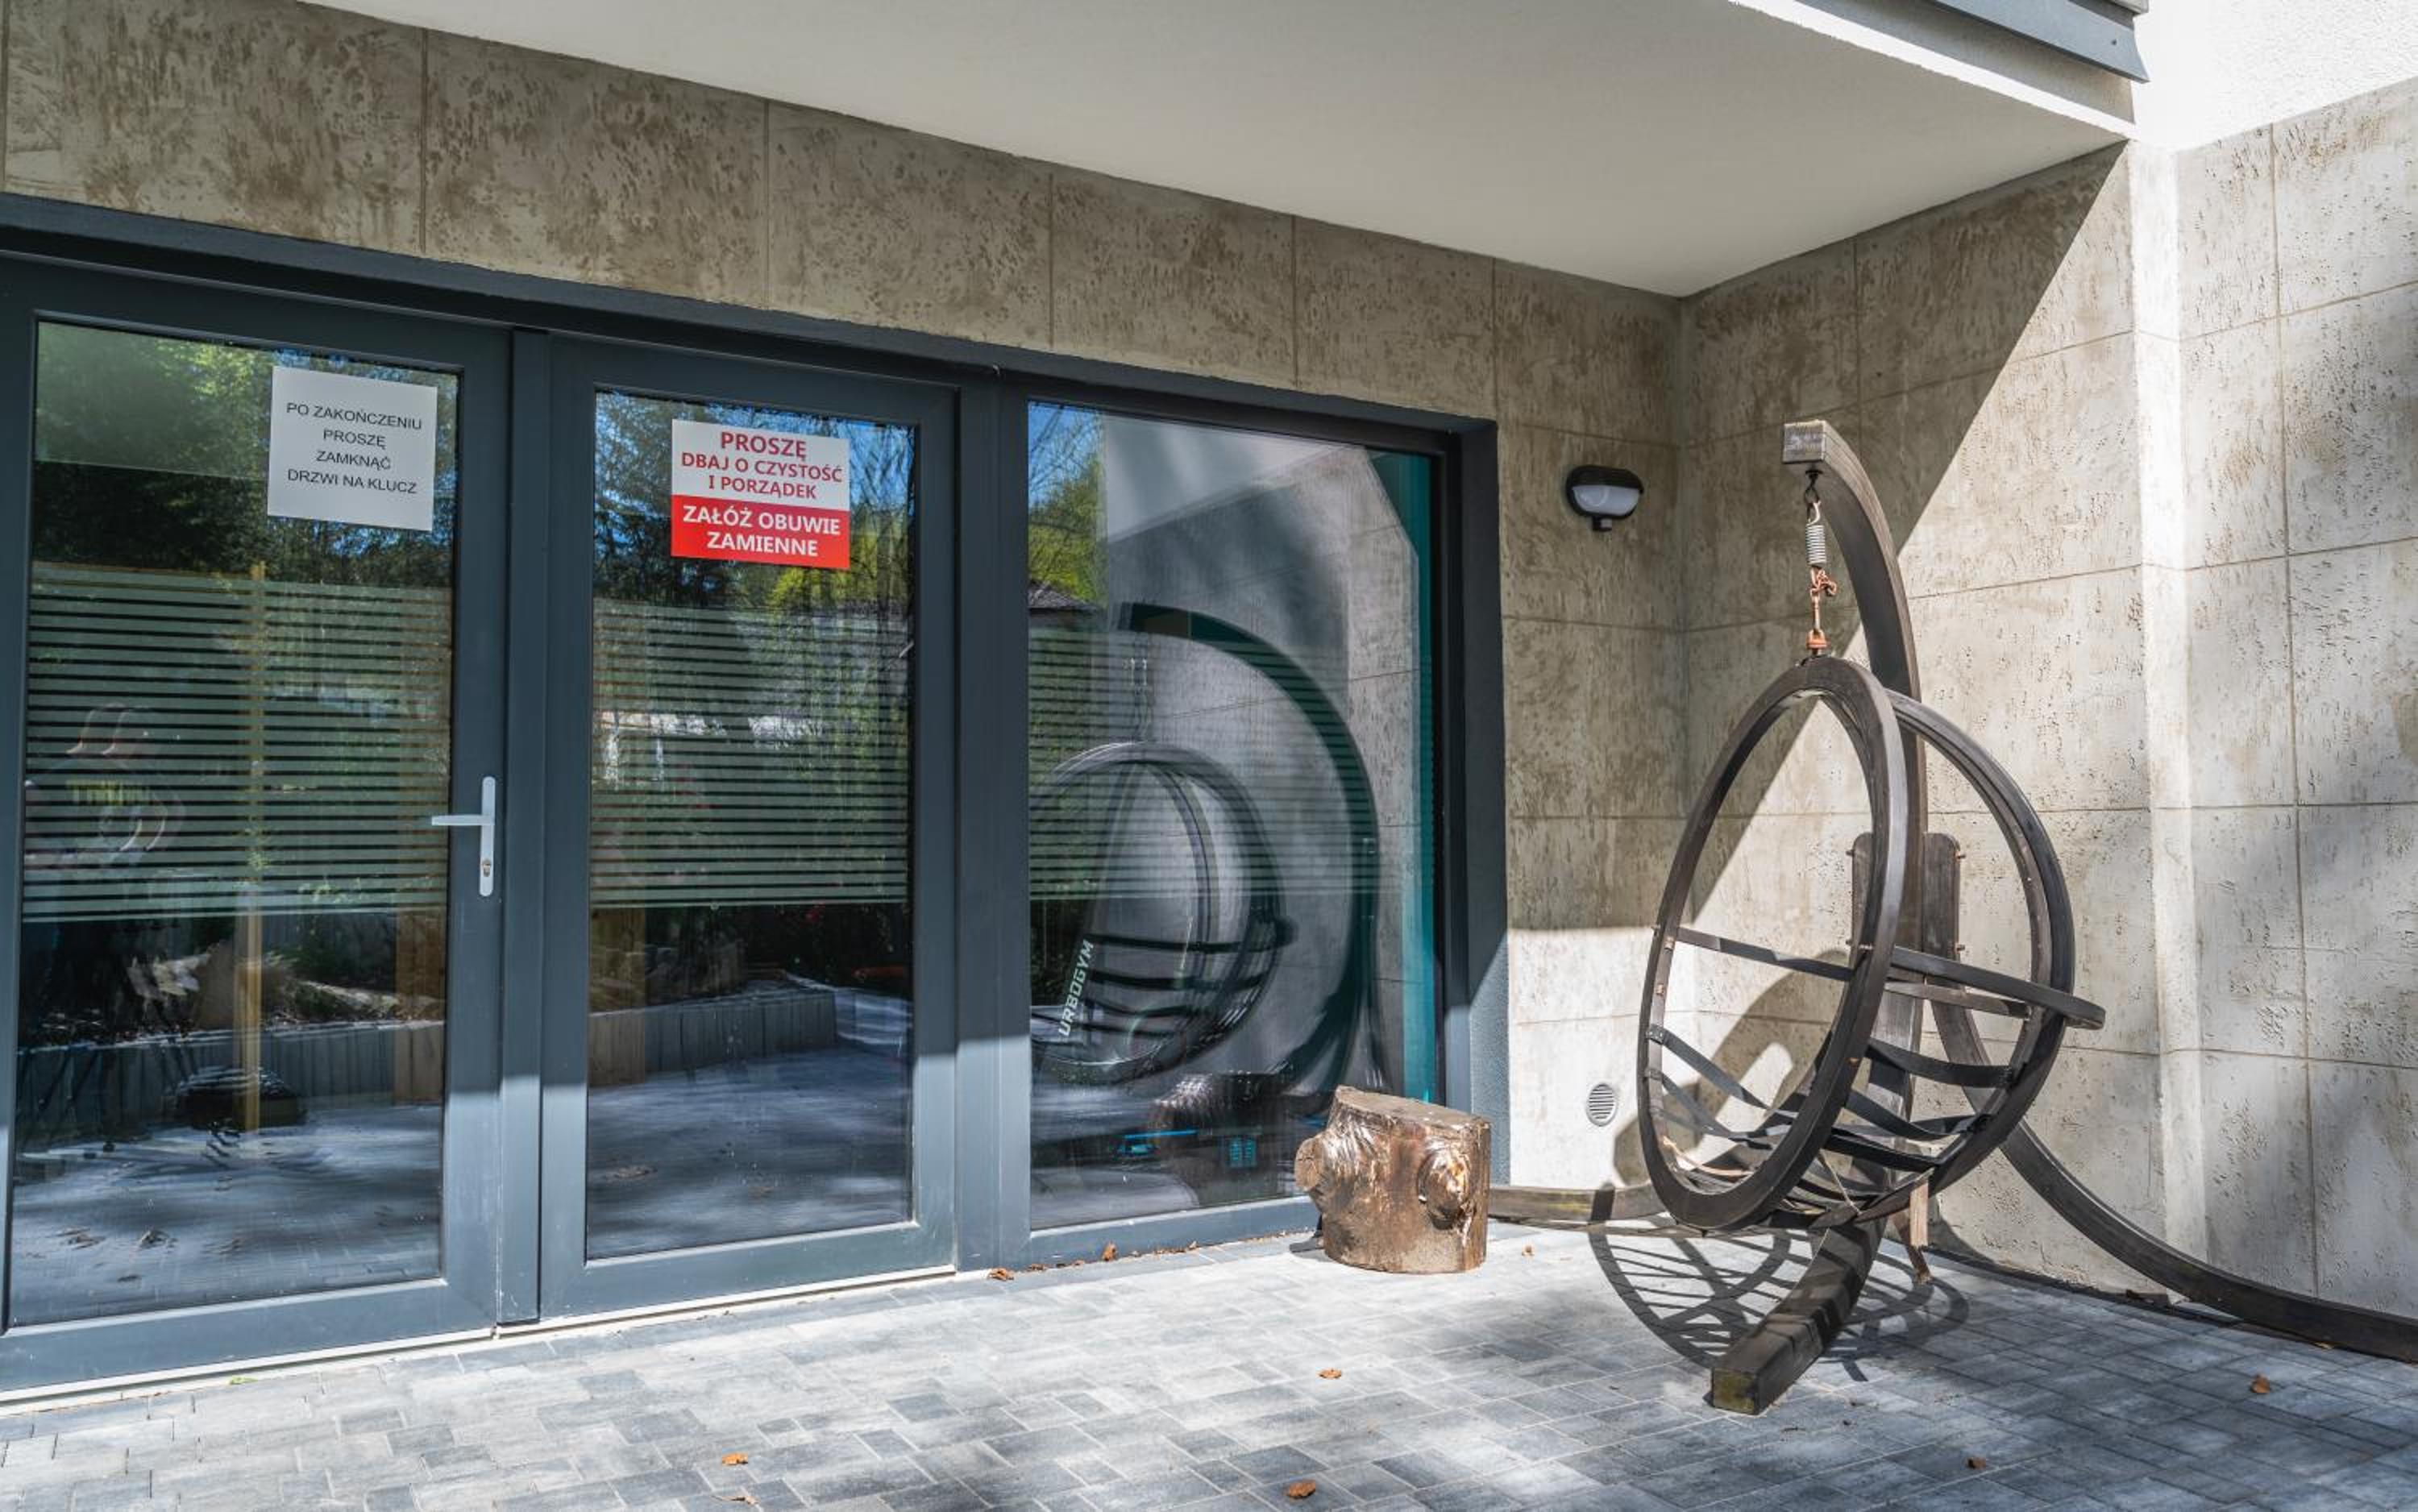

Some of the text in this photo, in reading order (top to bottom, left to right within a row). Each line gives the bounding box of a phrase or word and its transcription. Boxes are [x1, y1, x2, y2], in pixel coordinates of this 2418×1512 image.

[286, 401, 422, 430] PO ZAKOŃCZENIU
[323, 429, 387, 450] PROSZĘ
[721, 431, 807, 462] PROSZĘ
[316, 450, 392, 471] ZAMKNĄĆ
[682, 451, 843, 483] DBAJ O CZYSTOŚĆ
[287, 468, 418, 494] DRZWI NA KLUCZ
[708, 475, 817, 500] I PORZĄDEK
[683, 505, 841, 535] ZAŁÓŻ OBUWIE
[706, 531, 819, 557] ZAMIENNE
[1058, 939, 1095, 1037] URBOGYM
